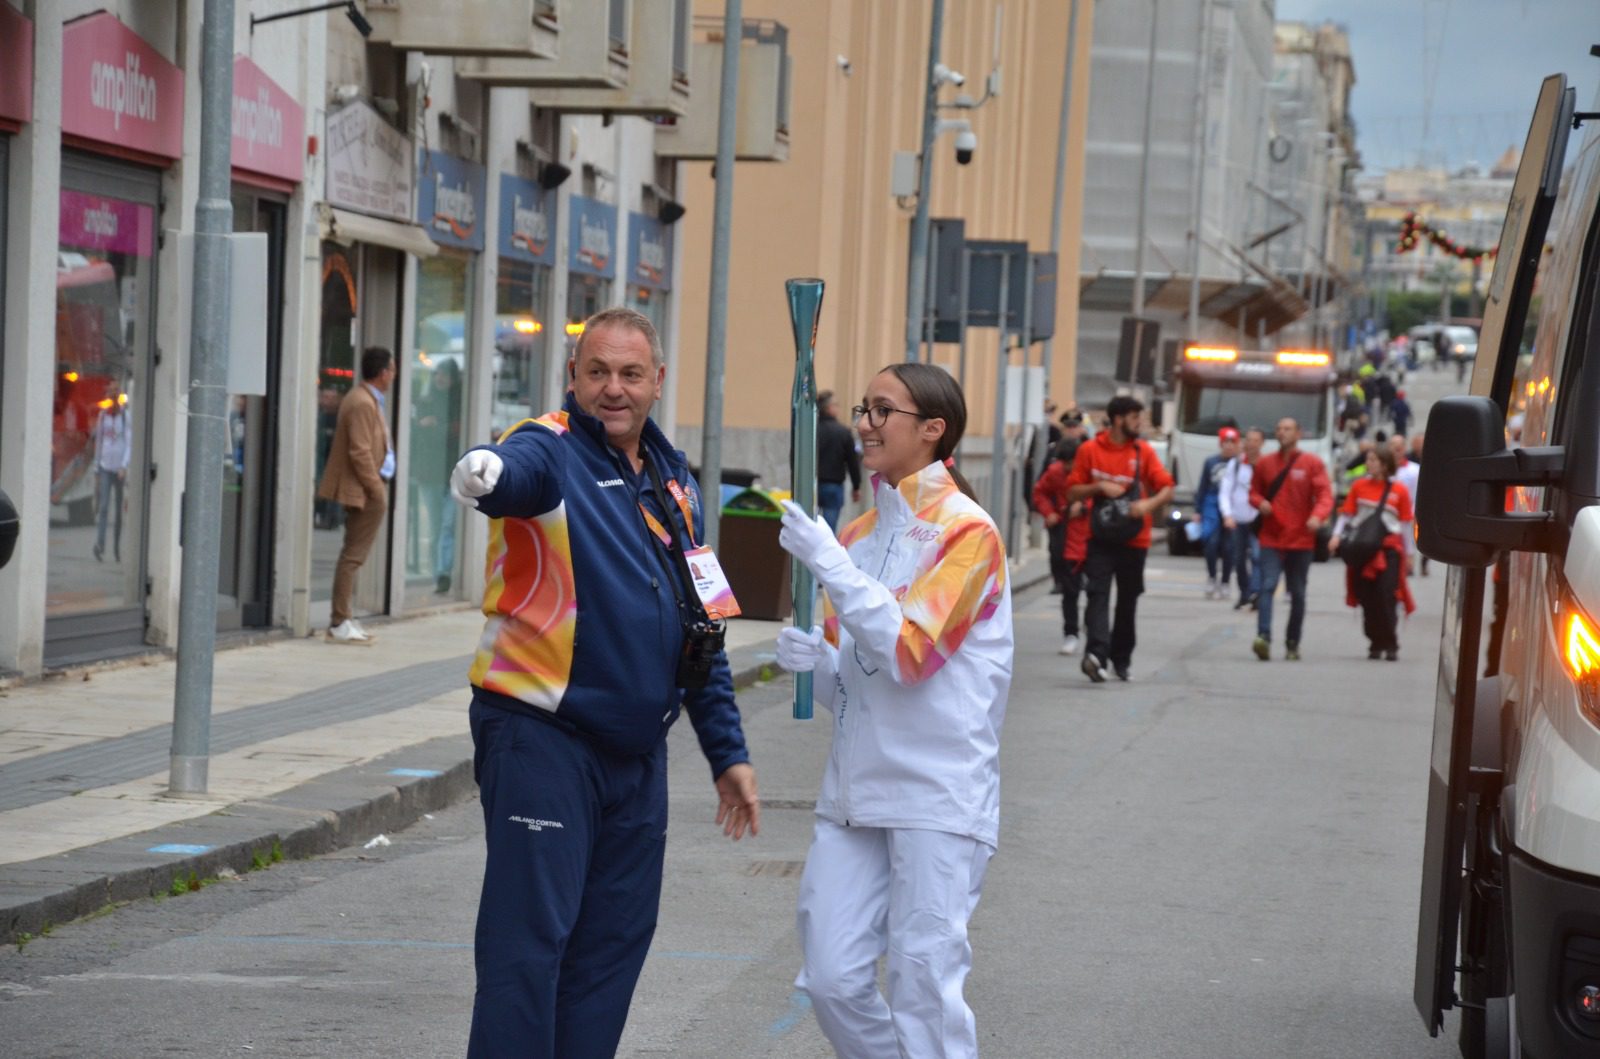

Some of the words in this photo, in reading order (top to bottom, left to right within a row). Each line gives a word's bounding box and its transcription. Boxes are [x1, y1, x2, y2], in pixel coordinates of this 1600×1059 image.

[91, 50, 156, 131] amplifon
[835, 671, 848, 729] MILAN
[508, 815, 535, 824] MILANO
[535, 819, 564, 828] CORTINA
